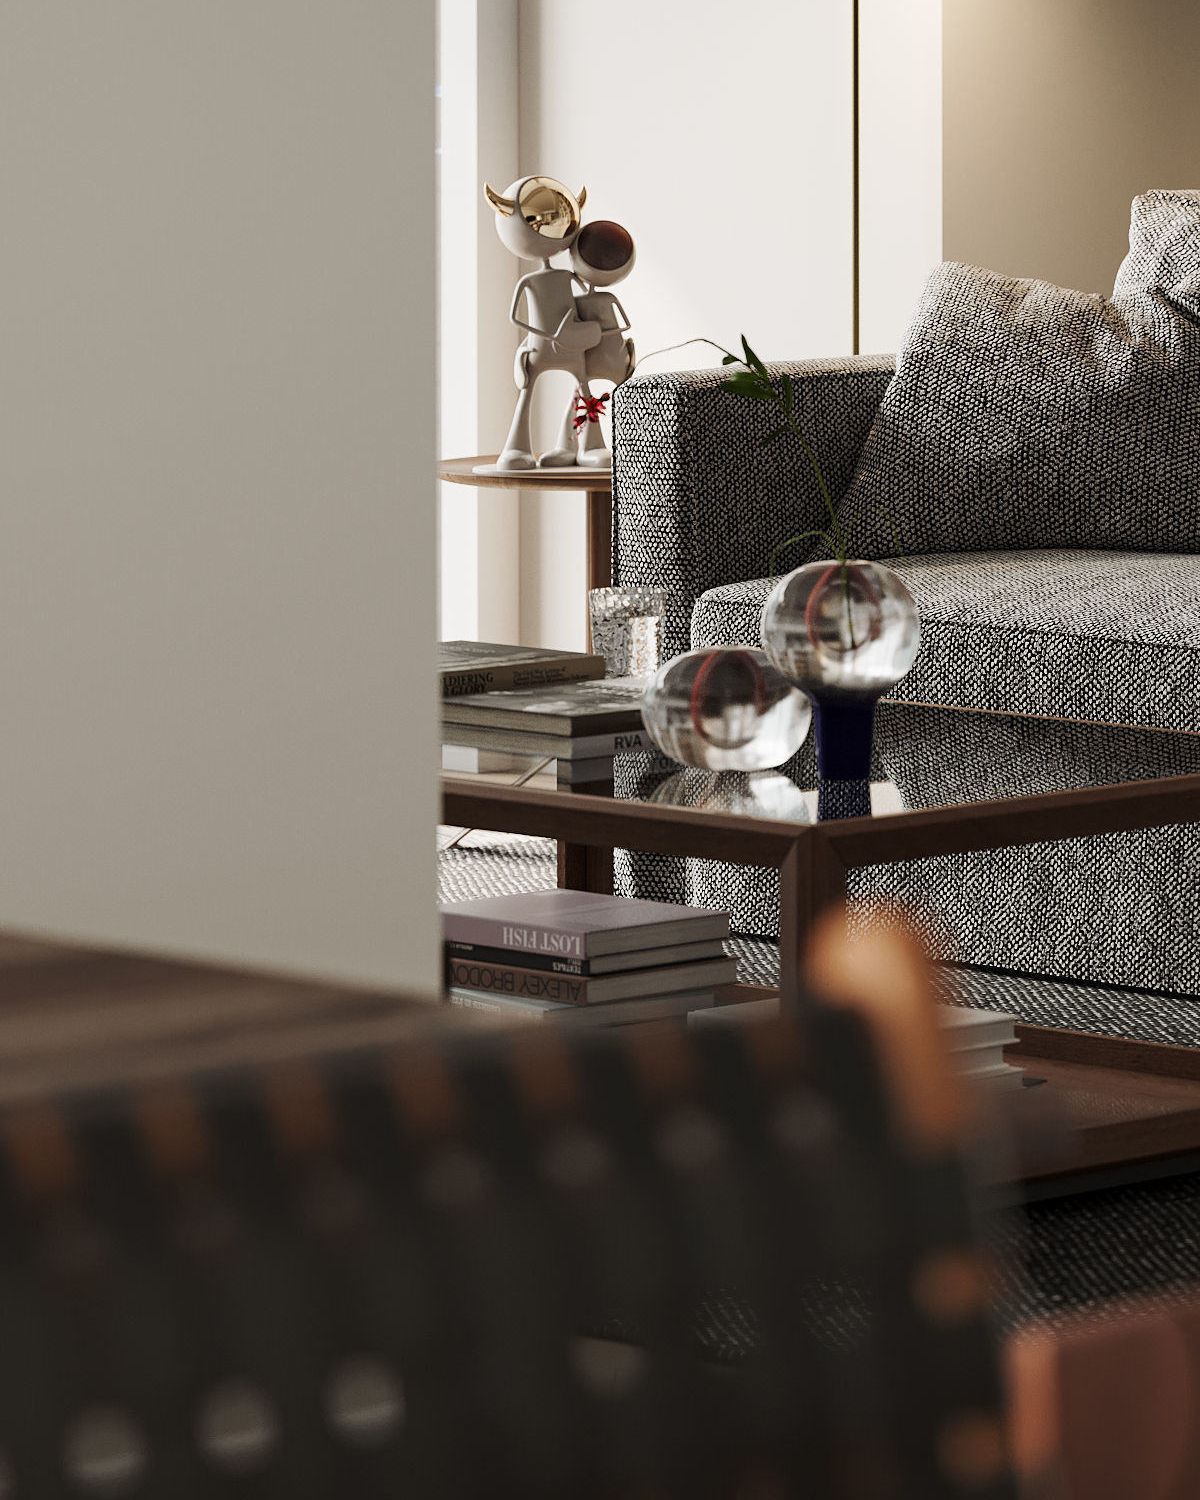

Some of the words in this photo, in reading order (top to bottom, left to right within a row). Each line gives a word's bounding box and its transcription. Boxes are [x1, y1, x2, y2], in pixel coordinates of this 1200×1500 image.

[613, 733, 643, 750] RVA
[503, 926, 537, 951] FISH
[540, 934, 582, 955] LOST
[519, 974, 583, 1000] ALEXEY
